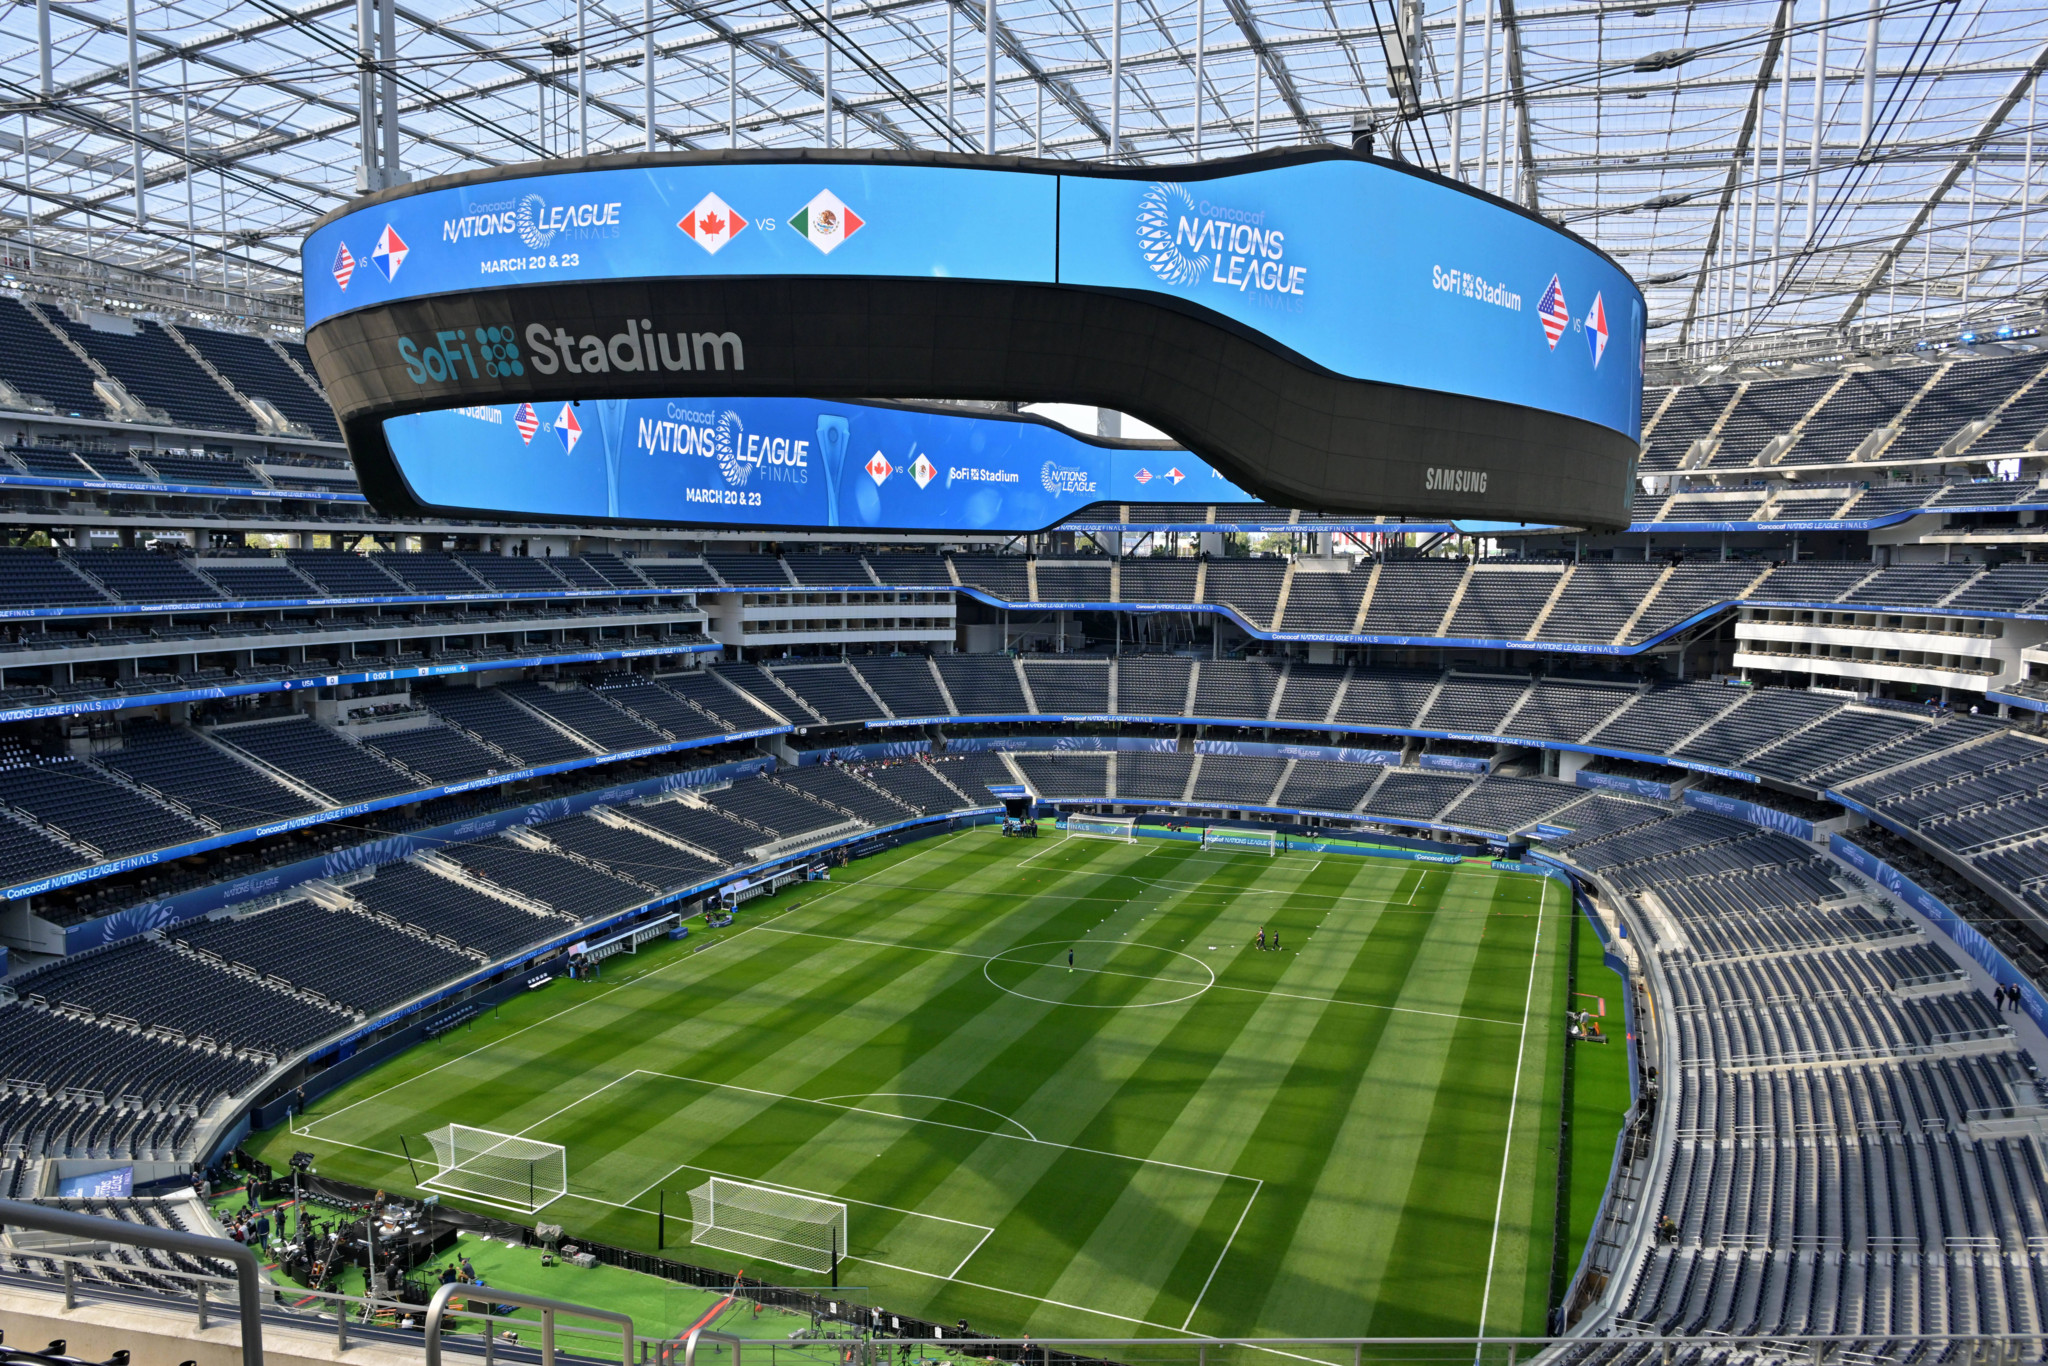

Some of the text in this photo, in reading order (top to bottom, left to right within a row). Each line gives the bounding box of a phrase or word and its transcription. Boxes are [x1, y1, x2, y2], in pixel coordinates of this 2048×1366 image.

[469, 197, 516, 214] Concacaf
[1199, 200, 1265, 226] Concacaf
[443, 202, 622, 243] NATIONS LEAGUE
[565, 227, 620, 241] FINALS
[1176, 215, 1285, 260] NATIONS
[481, 254, 579, 274] MARCH 20 & 23
[1212, 253, 1307, 295] LEAGUE
[1432, 264, 1521, 312] SoFi Stadium
[1248, 290, 1304, 314] FINALS
[398, 318, 745, 384] SoFi Stadium
[667, 402, 716, 426] Concacaf
[638, 417, 809, 468] NATIONS LEAGUE
[760, 465, 808, 484] FINALS
[950, 466, 1019, 482] SoFi Stadium
[1052, 470, 1088, 482] NATIONS
[1425, 467, 1487, 494] SAMSUNG
[686, 488, 762, 506] MARCH 20 & 23
[1062, 482, 1096, 492] LEAGUE
[0, 702, 102, 720] NATIONS LEAGUE FINALS
[596, 755, 616, 763] Concacaf
[652, 745, 672, 753] FINALS
[444, 770, 534, 794] Concacaf NATIONS LEAGUE FINALS
[1729, 770, 1752, 781] FINALS
[256, 804, 368, 836] Concacaf NATIONS LEAGUE FINALS
[1416, 854, 1444, 862] Concacaf
[1492, 862, 1520, 870] FINALS
[7, 852, 158, 899] Concacaf NATIONS LEAGUE FINALS
